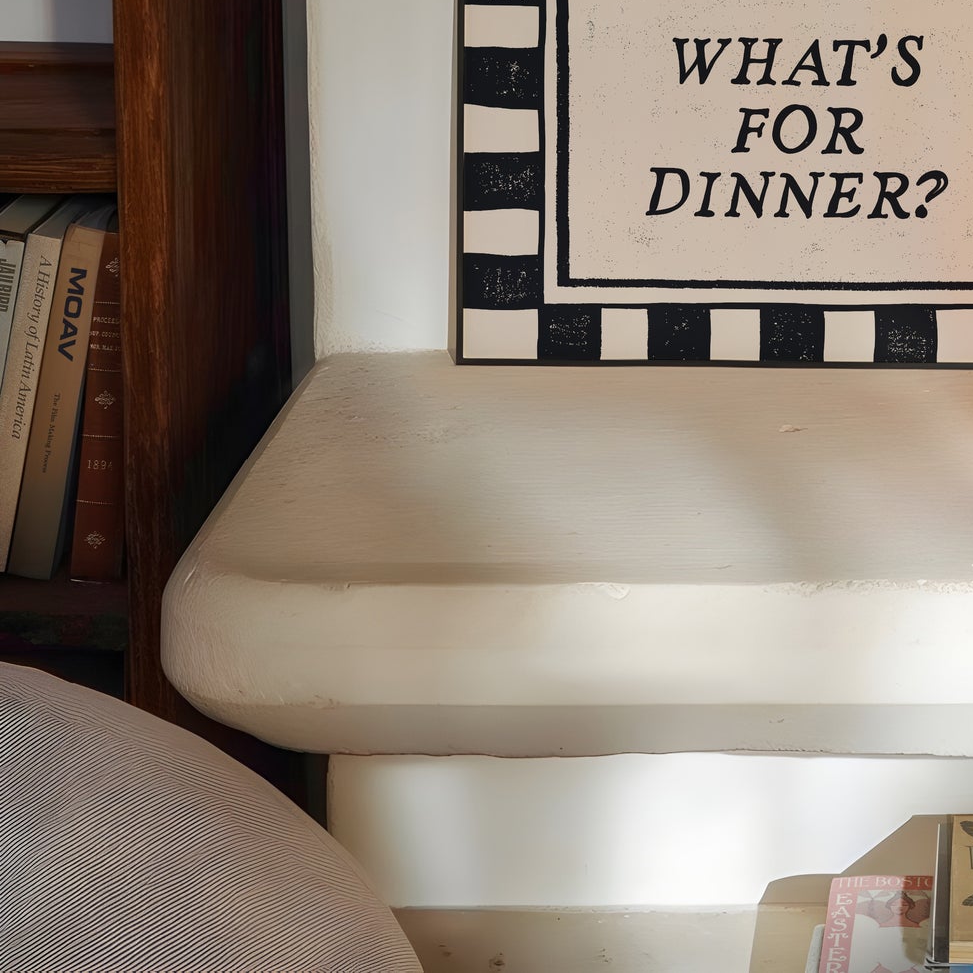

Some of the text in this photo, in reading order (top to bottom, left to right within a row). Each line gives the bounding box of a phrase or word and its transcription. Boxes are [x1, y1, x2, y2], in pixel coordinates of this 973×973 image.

[730, 104, 866, 155] FOR
[645, 166, 950, 220] DINNER?
[57, 267, 88, 362] MOAV
[12, 255, 52, 440] A History of Latin America
[837, 876, 870, 888] THE
